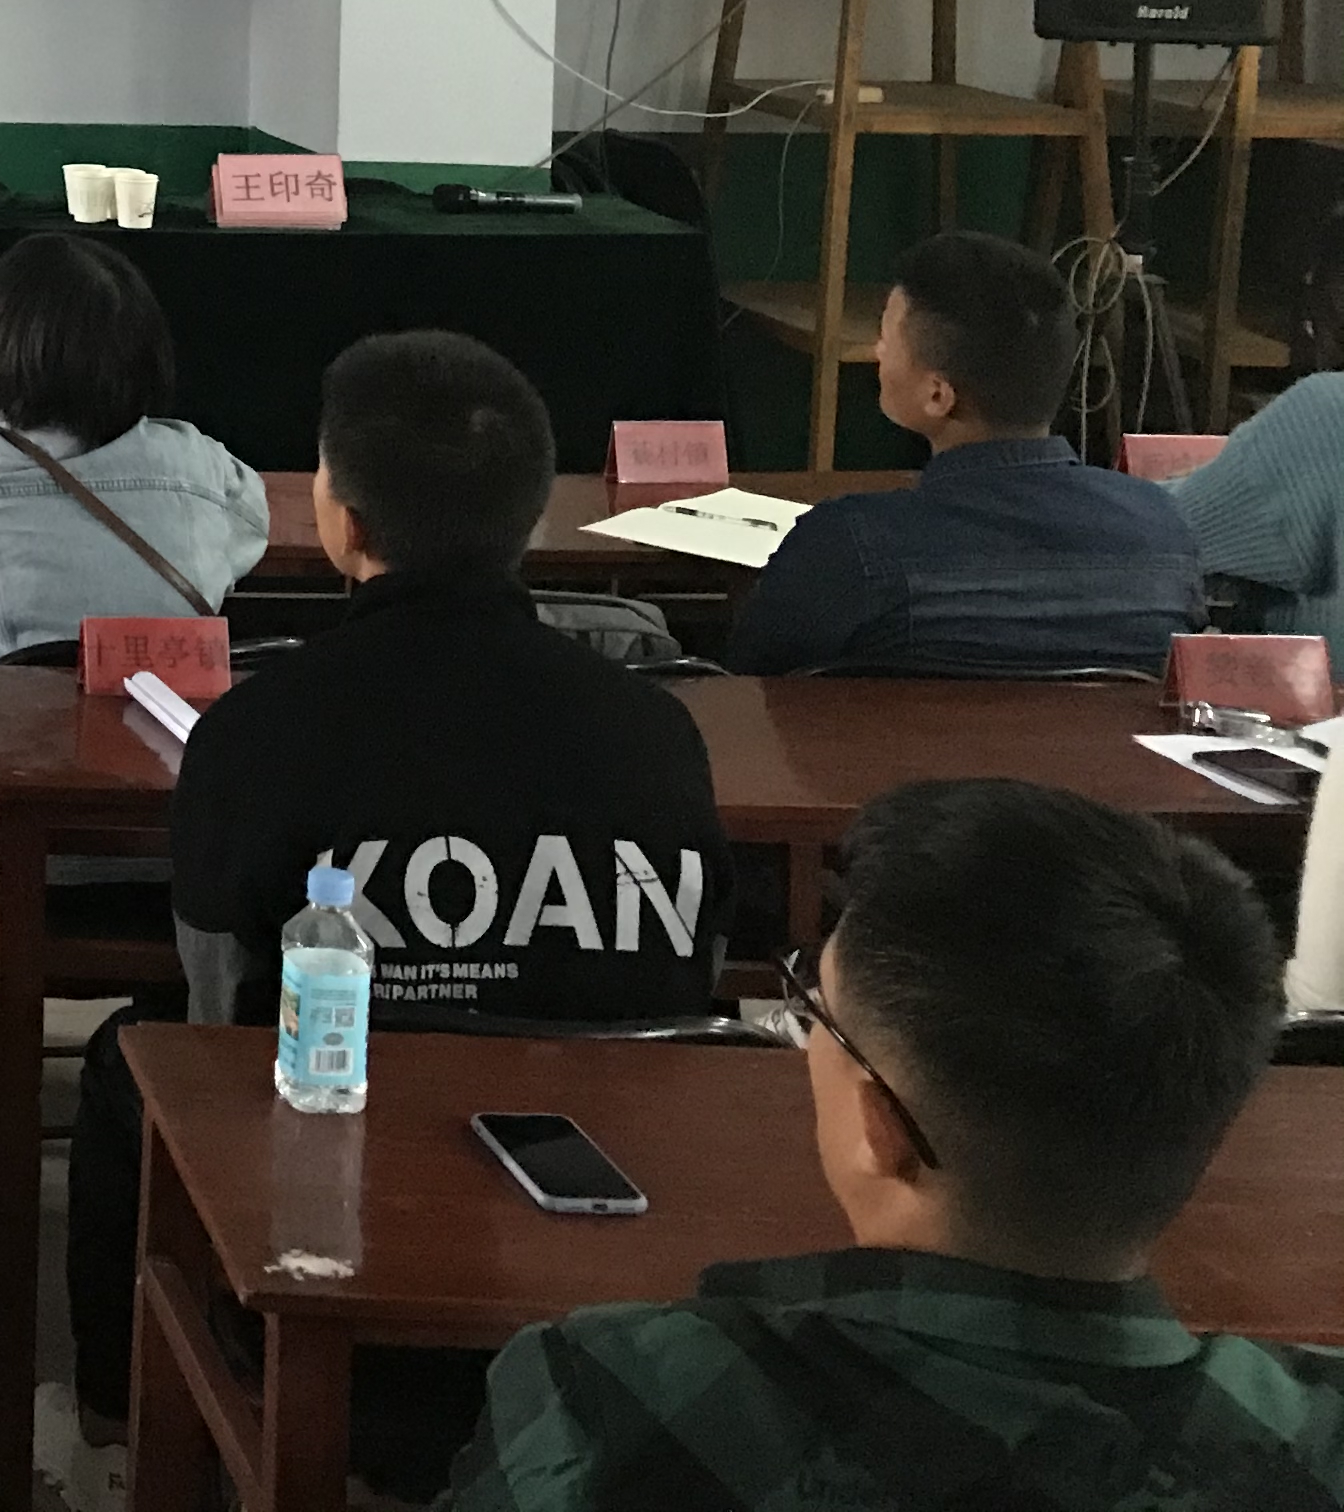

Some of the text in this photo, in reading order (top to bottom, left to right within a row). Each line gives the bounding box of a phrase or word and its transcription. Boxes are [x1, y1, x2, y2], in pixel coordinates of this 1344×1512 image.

[231, 170, 338, 203] 王印奇
[315, 834, 704, 957] KOAN
[452, 962, 520, 979] MEANS
[392, 983, 478, 1001] PARTNER
